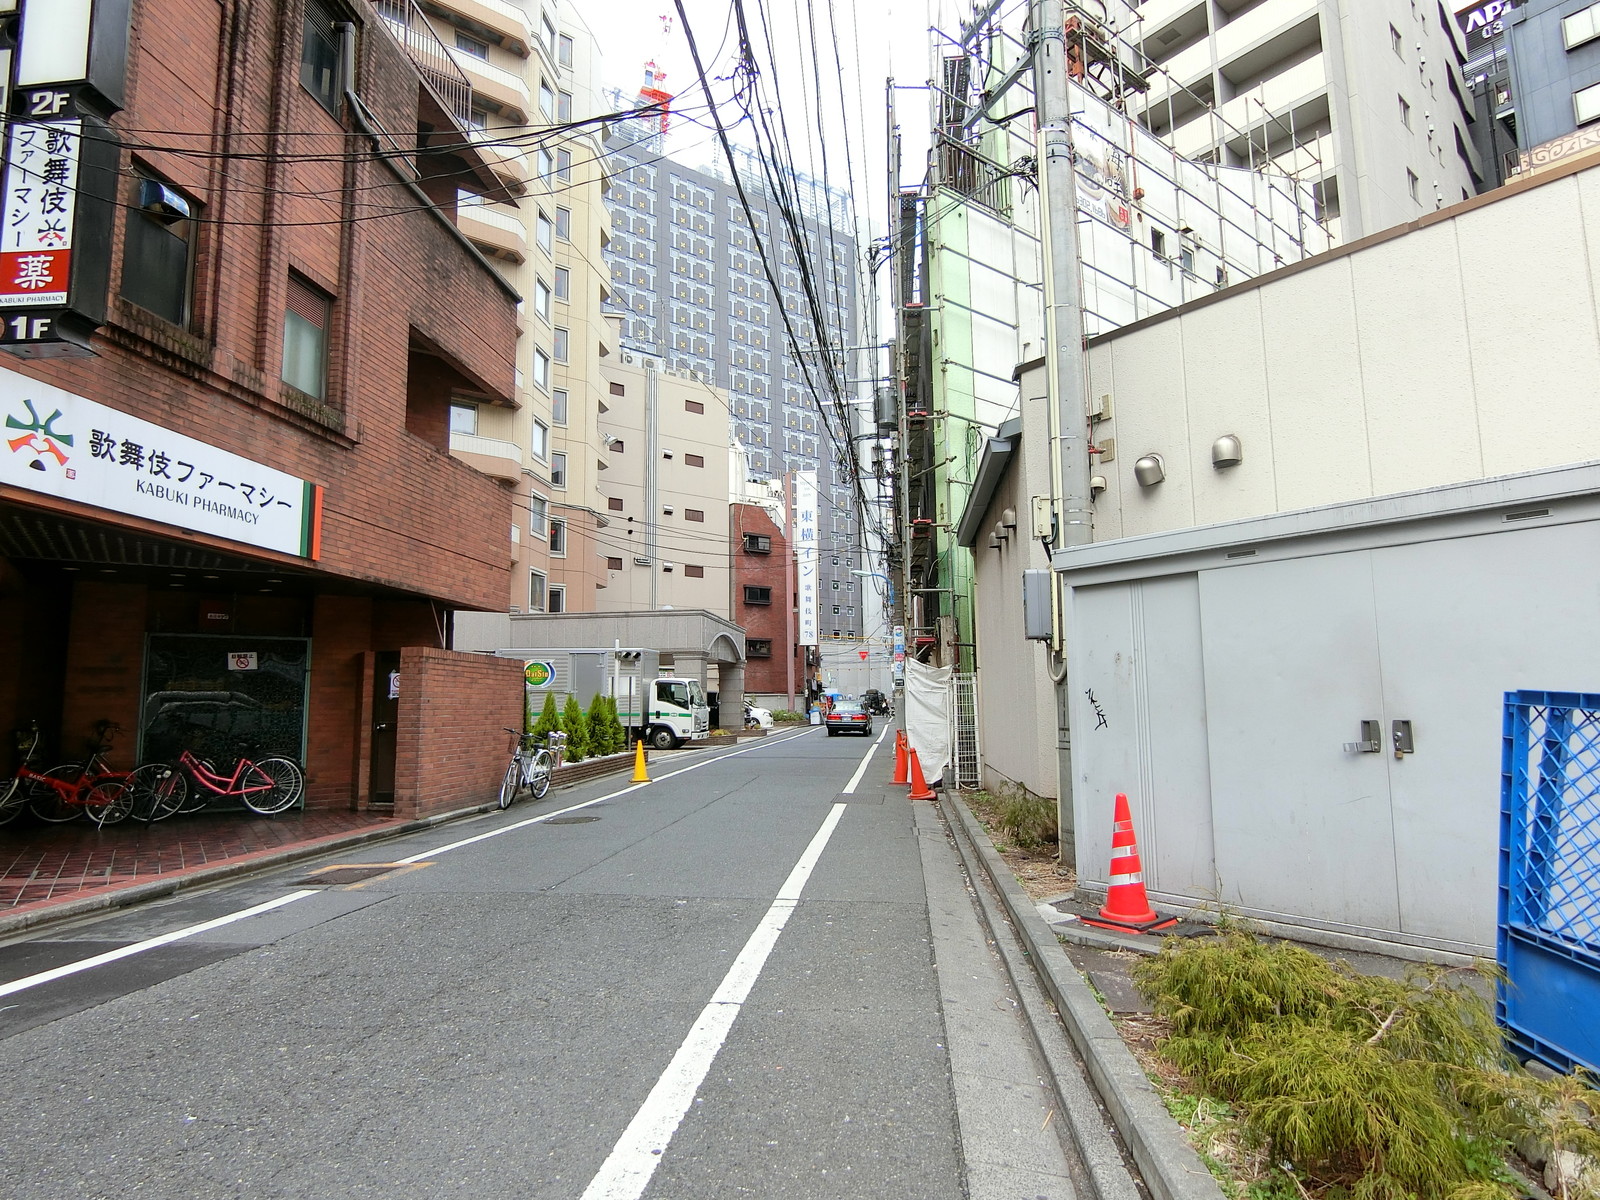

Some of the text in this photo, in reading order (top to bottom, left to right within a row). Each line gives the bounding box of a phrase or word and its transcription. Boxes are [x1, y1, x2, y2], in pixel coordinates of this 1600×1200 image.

[1482, 20, 1503, 38] 03
[31, 91, 70, 115] 2F
[12, 130, 36, 247] ファーマシー
[41, 127, 71, 214] 歌舞伎
[14, 254, 54, 289] 薬
[26, 295, 65, 303] PHARMACY
[11, 316, 51, 339] 1F
[89, 429, 292, 508] 歌舞伎ファーマシー
[136, 479, 260, 525] KABUKI PHARMACY
[801, 510, 814, 577] 東横イン
